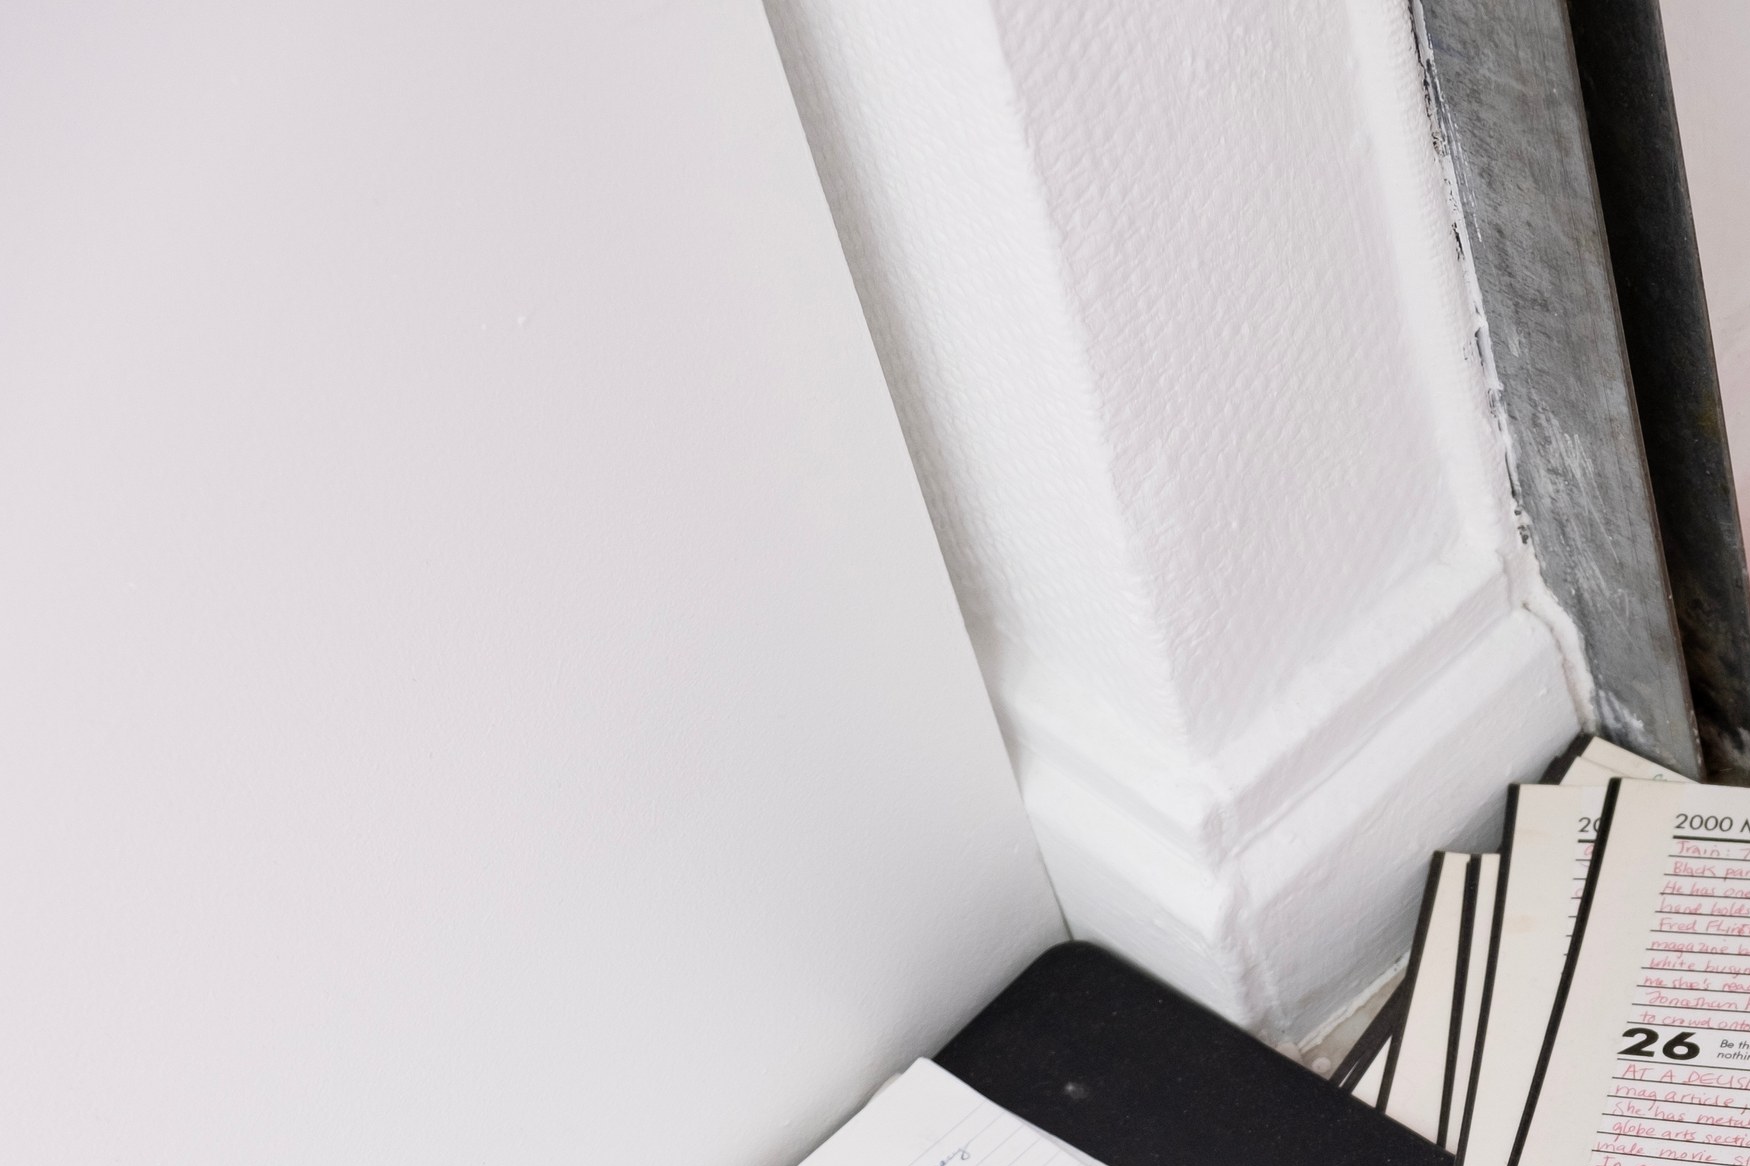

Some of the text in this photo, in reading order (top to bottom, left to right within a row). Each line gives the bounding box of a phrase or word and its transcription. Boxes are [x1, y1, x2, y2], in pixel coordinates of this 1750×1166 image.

[1674, 813, 1733, 832] 2000
[1617, 1027, 1701, 1061] 26
[1720, 1039, 1735, 1050] Be
